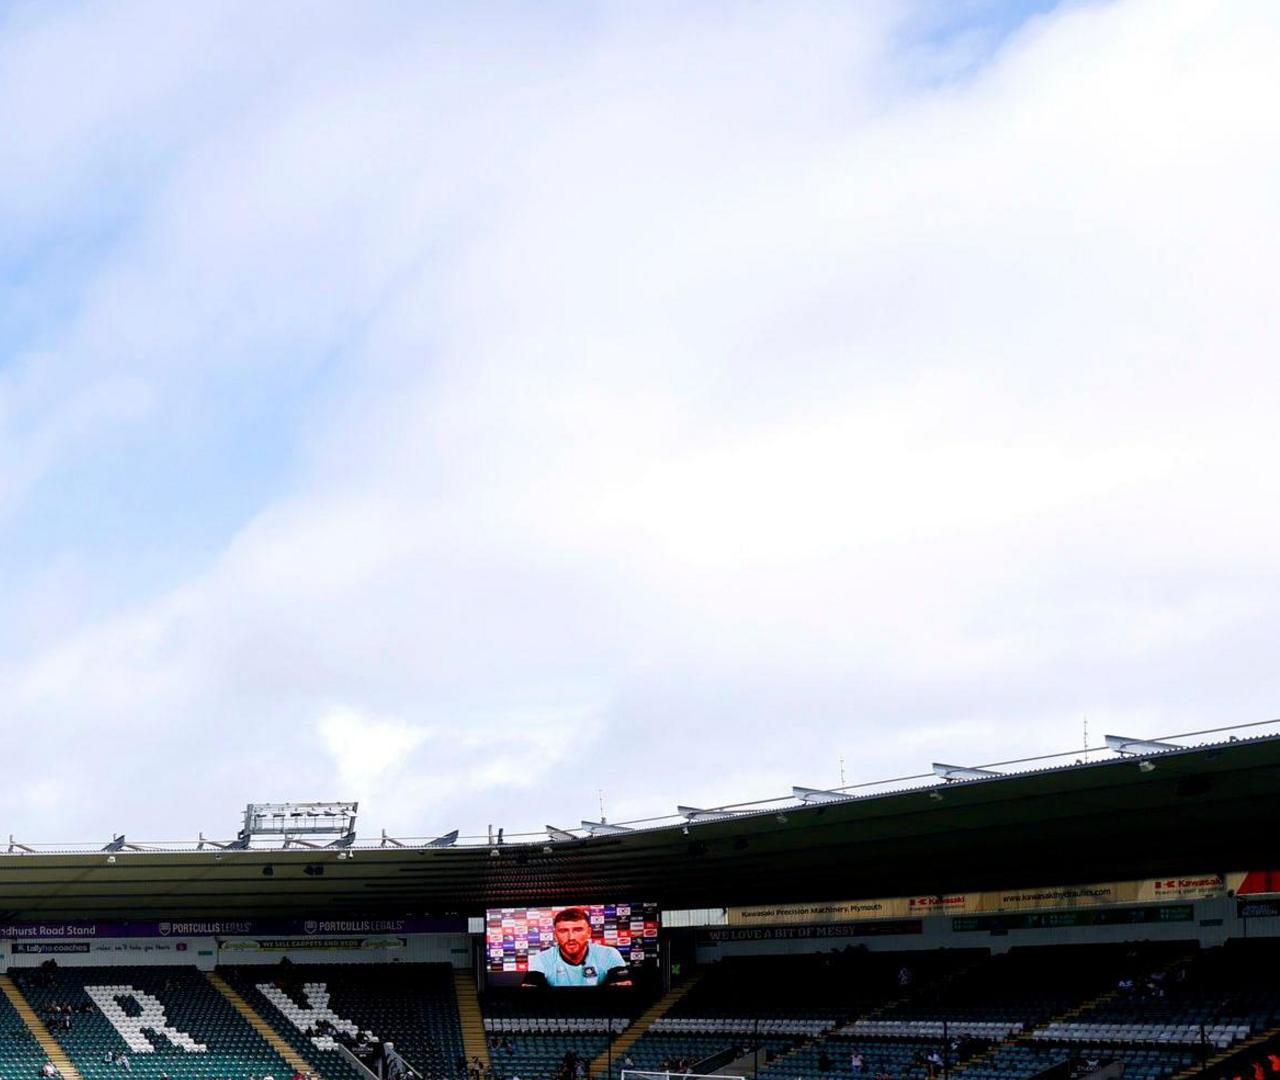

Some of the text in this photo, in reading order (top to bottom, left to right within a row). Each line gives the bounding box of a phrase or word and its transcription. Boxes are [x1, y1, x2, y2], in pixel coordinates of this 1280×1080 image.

[1178, 877, 1224, 888] Kawasaki
[928, 896, 965, 905] Kawasaki
[776, 908, 809, 918] Precision
[850, 903, 882, 914] Plymouth
[39, 926, 65, 936] Road
[67, 925, 97, 936] Stand
[172, 922, 219, 933] PORTCULLIS
[319, 920, 370, 931] PORTCULLIS
